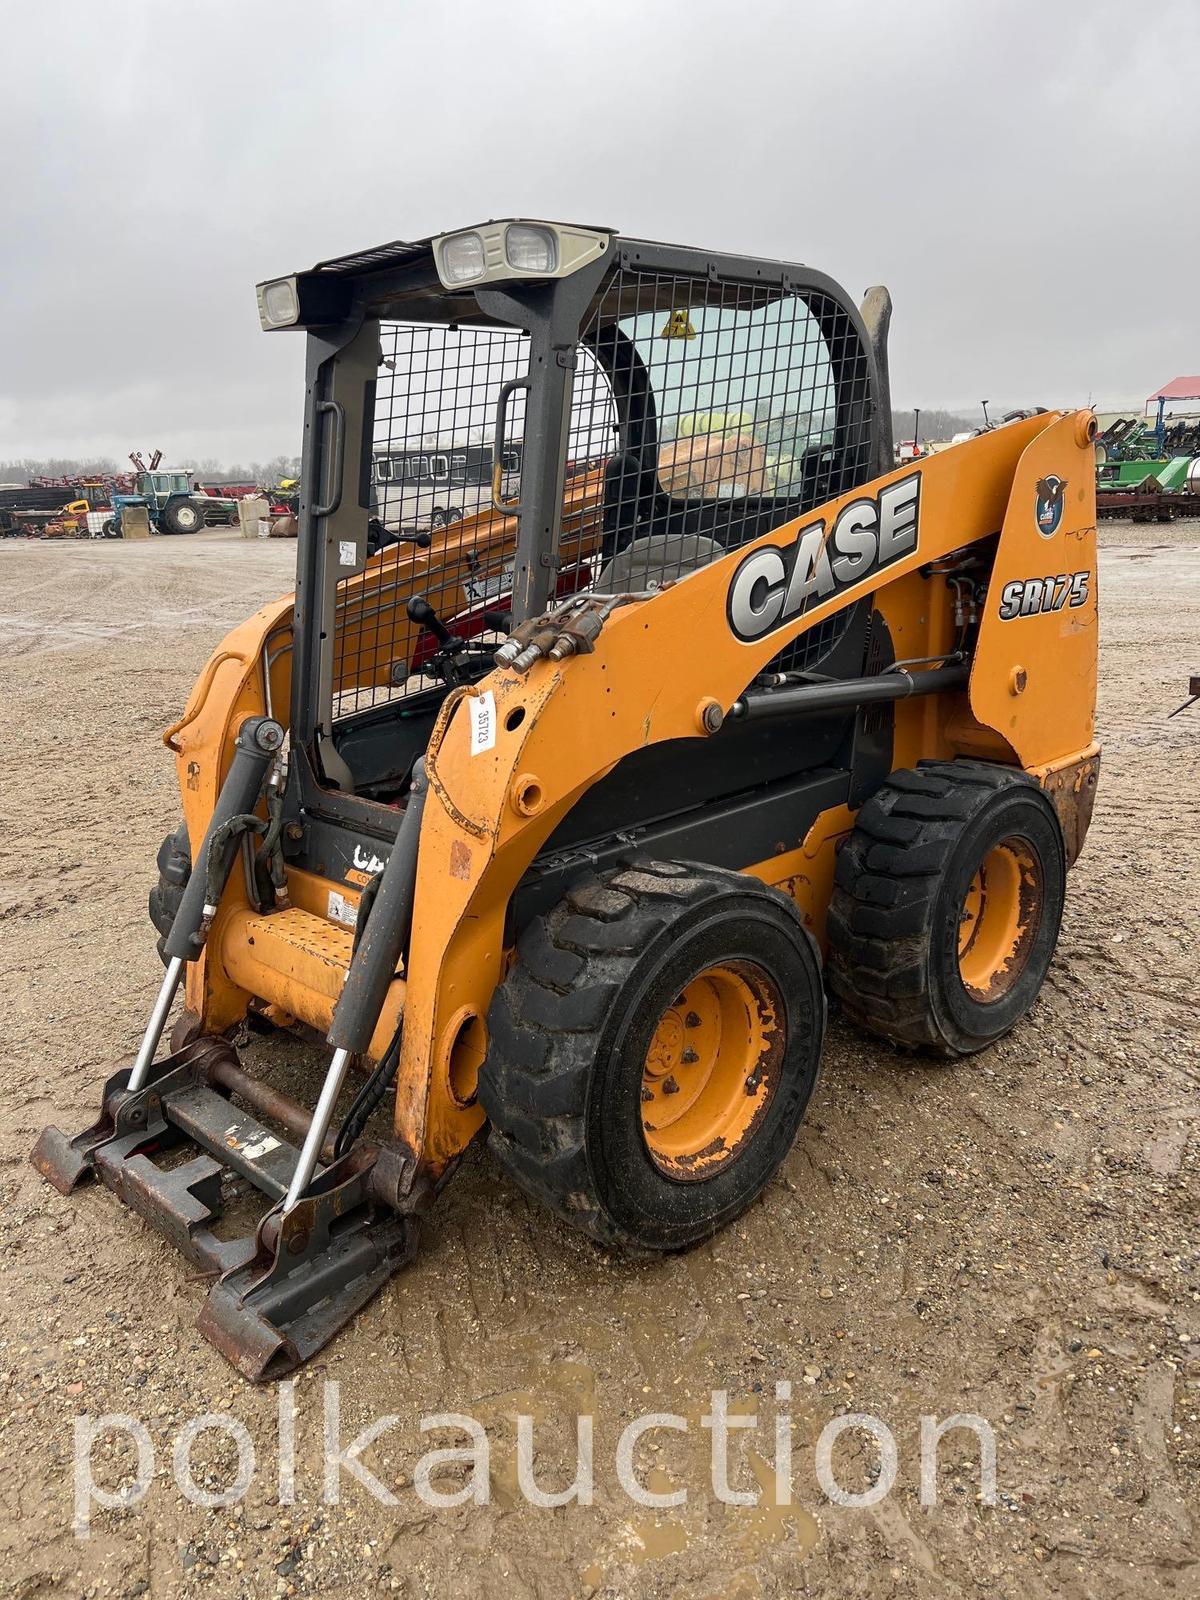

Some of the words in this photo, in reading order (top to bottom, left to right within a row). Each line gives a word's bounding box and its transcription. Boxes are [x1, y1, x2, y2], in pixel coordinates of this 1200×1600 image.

[728, 473, 920, 643] CASE
[1000, 571, 1090, 620] SR175
[478, 710, 489, 743] 35723
